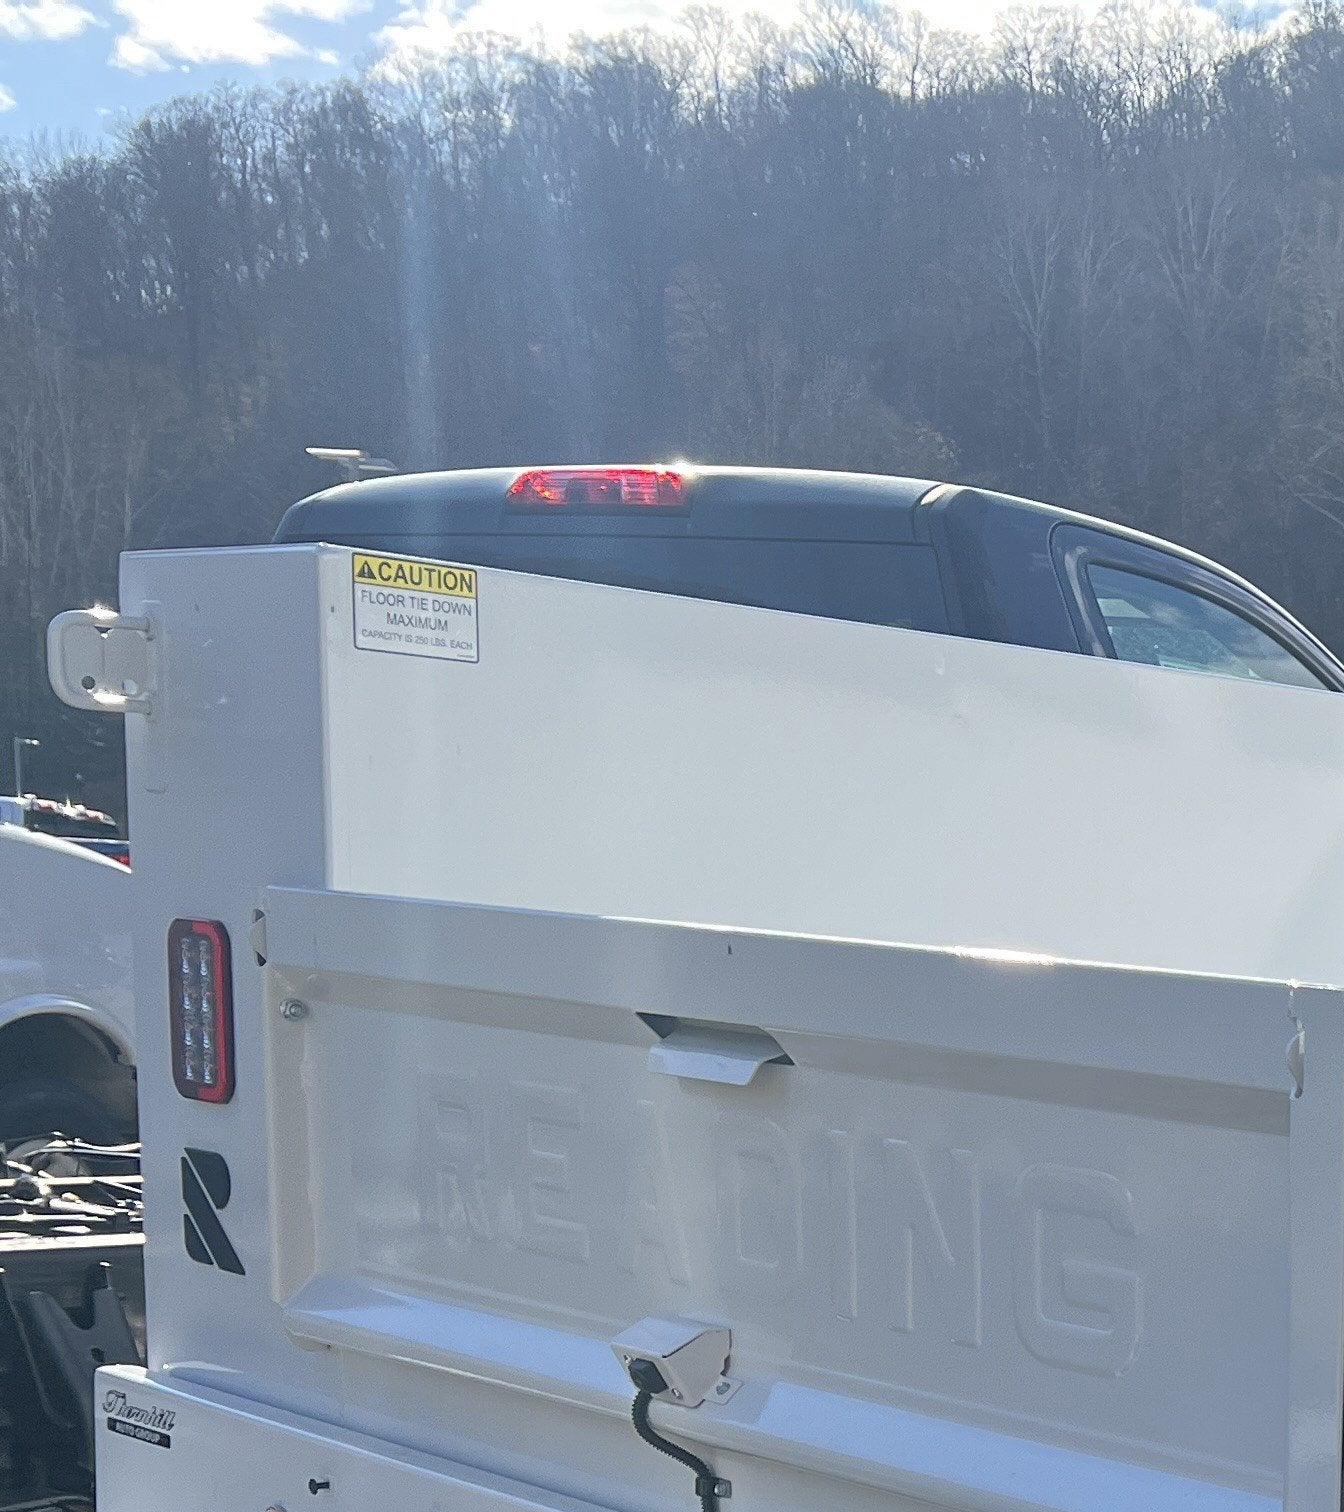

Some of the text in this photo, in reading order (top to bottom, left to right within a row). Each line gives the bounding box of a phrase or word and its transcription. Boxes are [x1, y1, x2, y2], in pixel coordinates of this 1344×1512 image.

[378, 561, 473, 593] CAUTION
[361, 589, 472, 617] FLOOR TIE DOWN
[386, 611, 449, 632] MAXIMUM
[361, 628, 402, 642] CAPACITY
[404, 634, 413, 643] IS
[414, 635, 429, 645] 250
[449, 639, 473, 650] EACH
[416, 1066, 1144, 1379] READING
